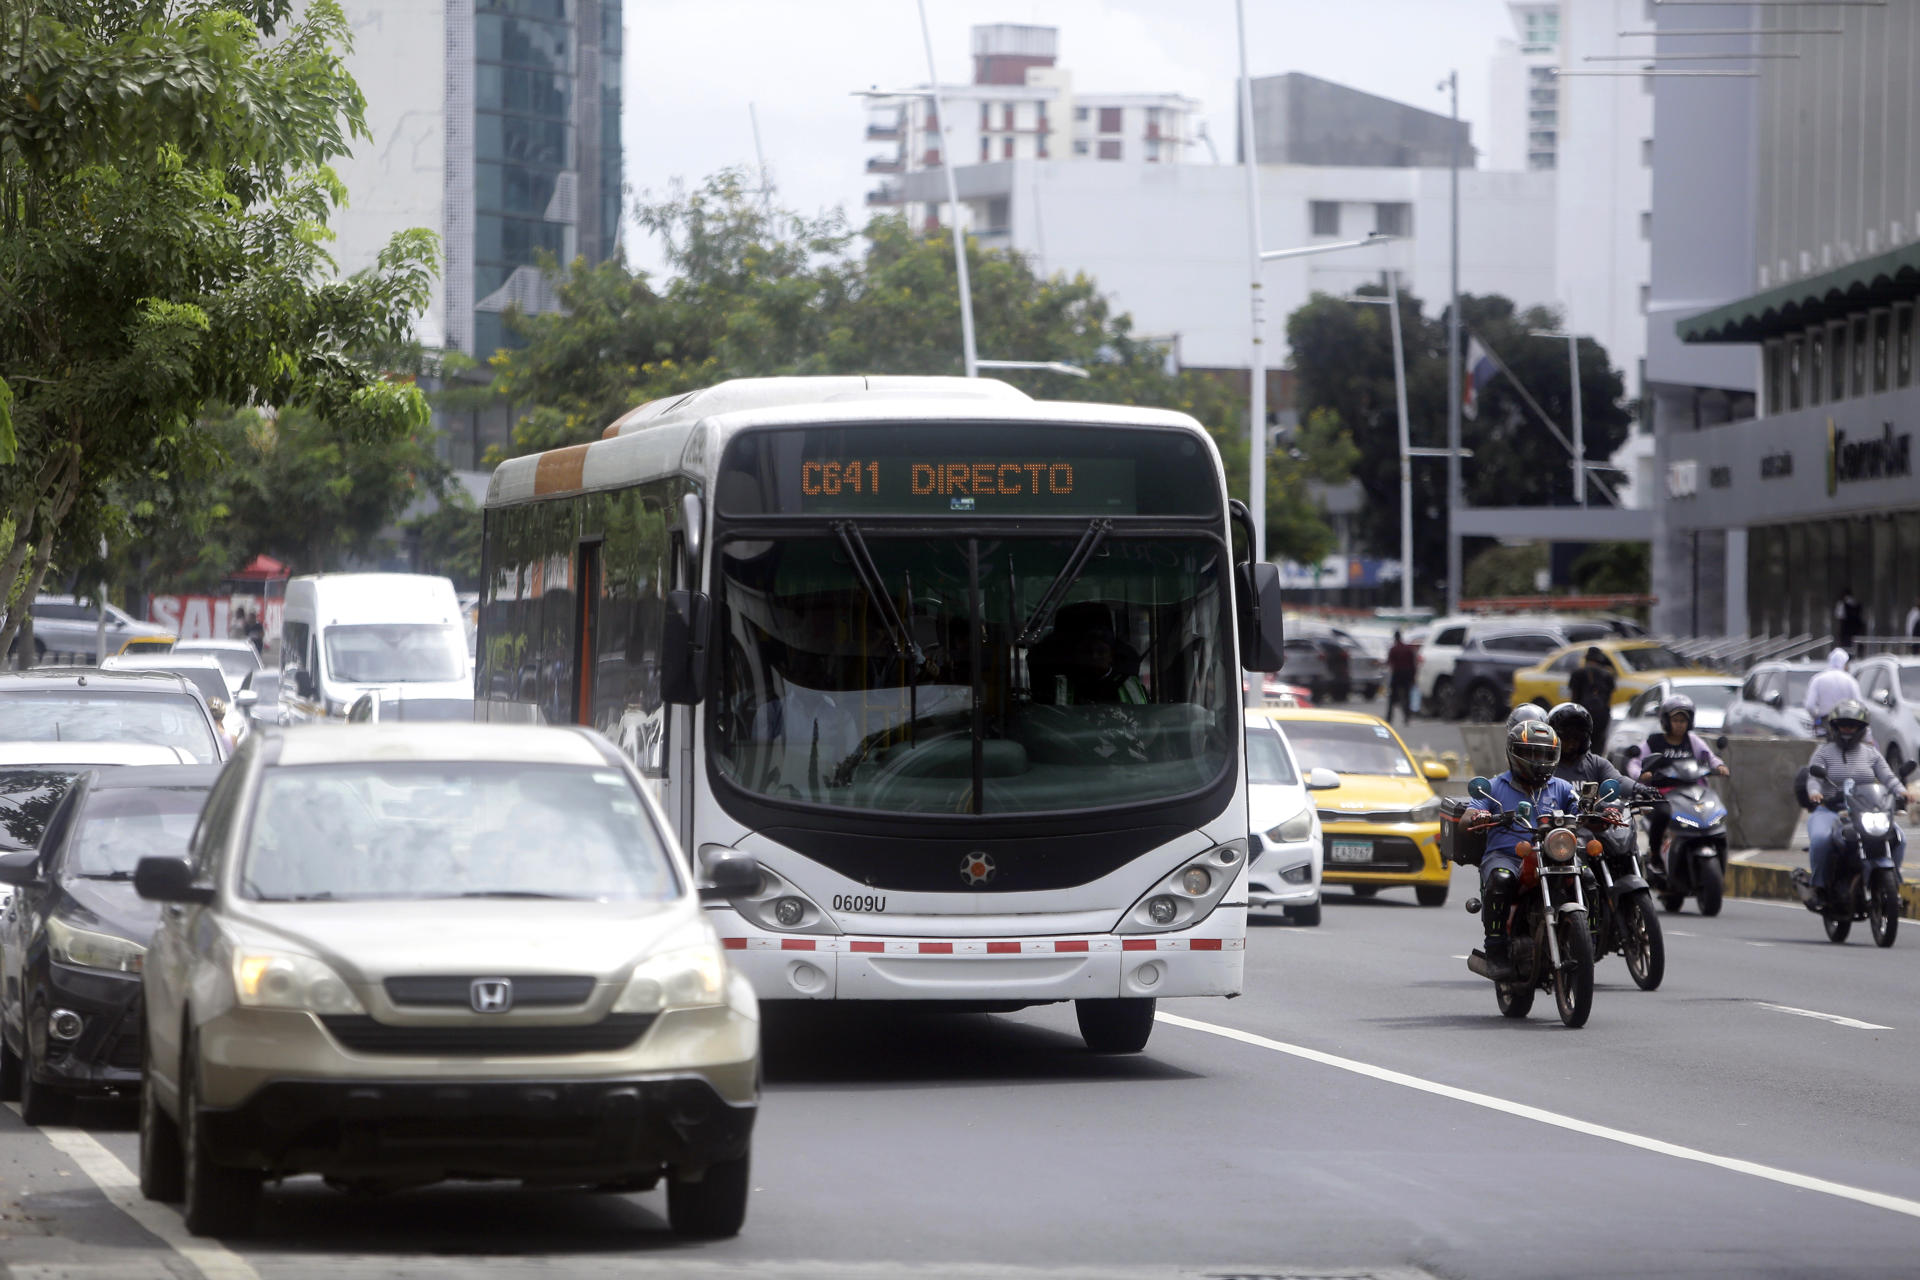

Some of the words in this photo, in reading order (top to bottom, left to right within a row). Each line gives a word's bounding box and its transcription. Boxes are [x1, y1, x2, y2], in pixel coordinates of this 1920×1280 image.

[801, 460, 880, 495] C641
[911, 463, 1073, 495] DIRECTO
[833, 894, 886, 912] 0609U
